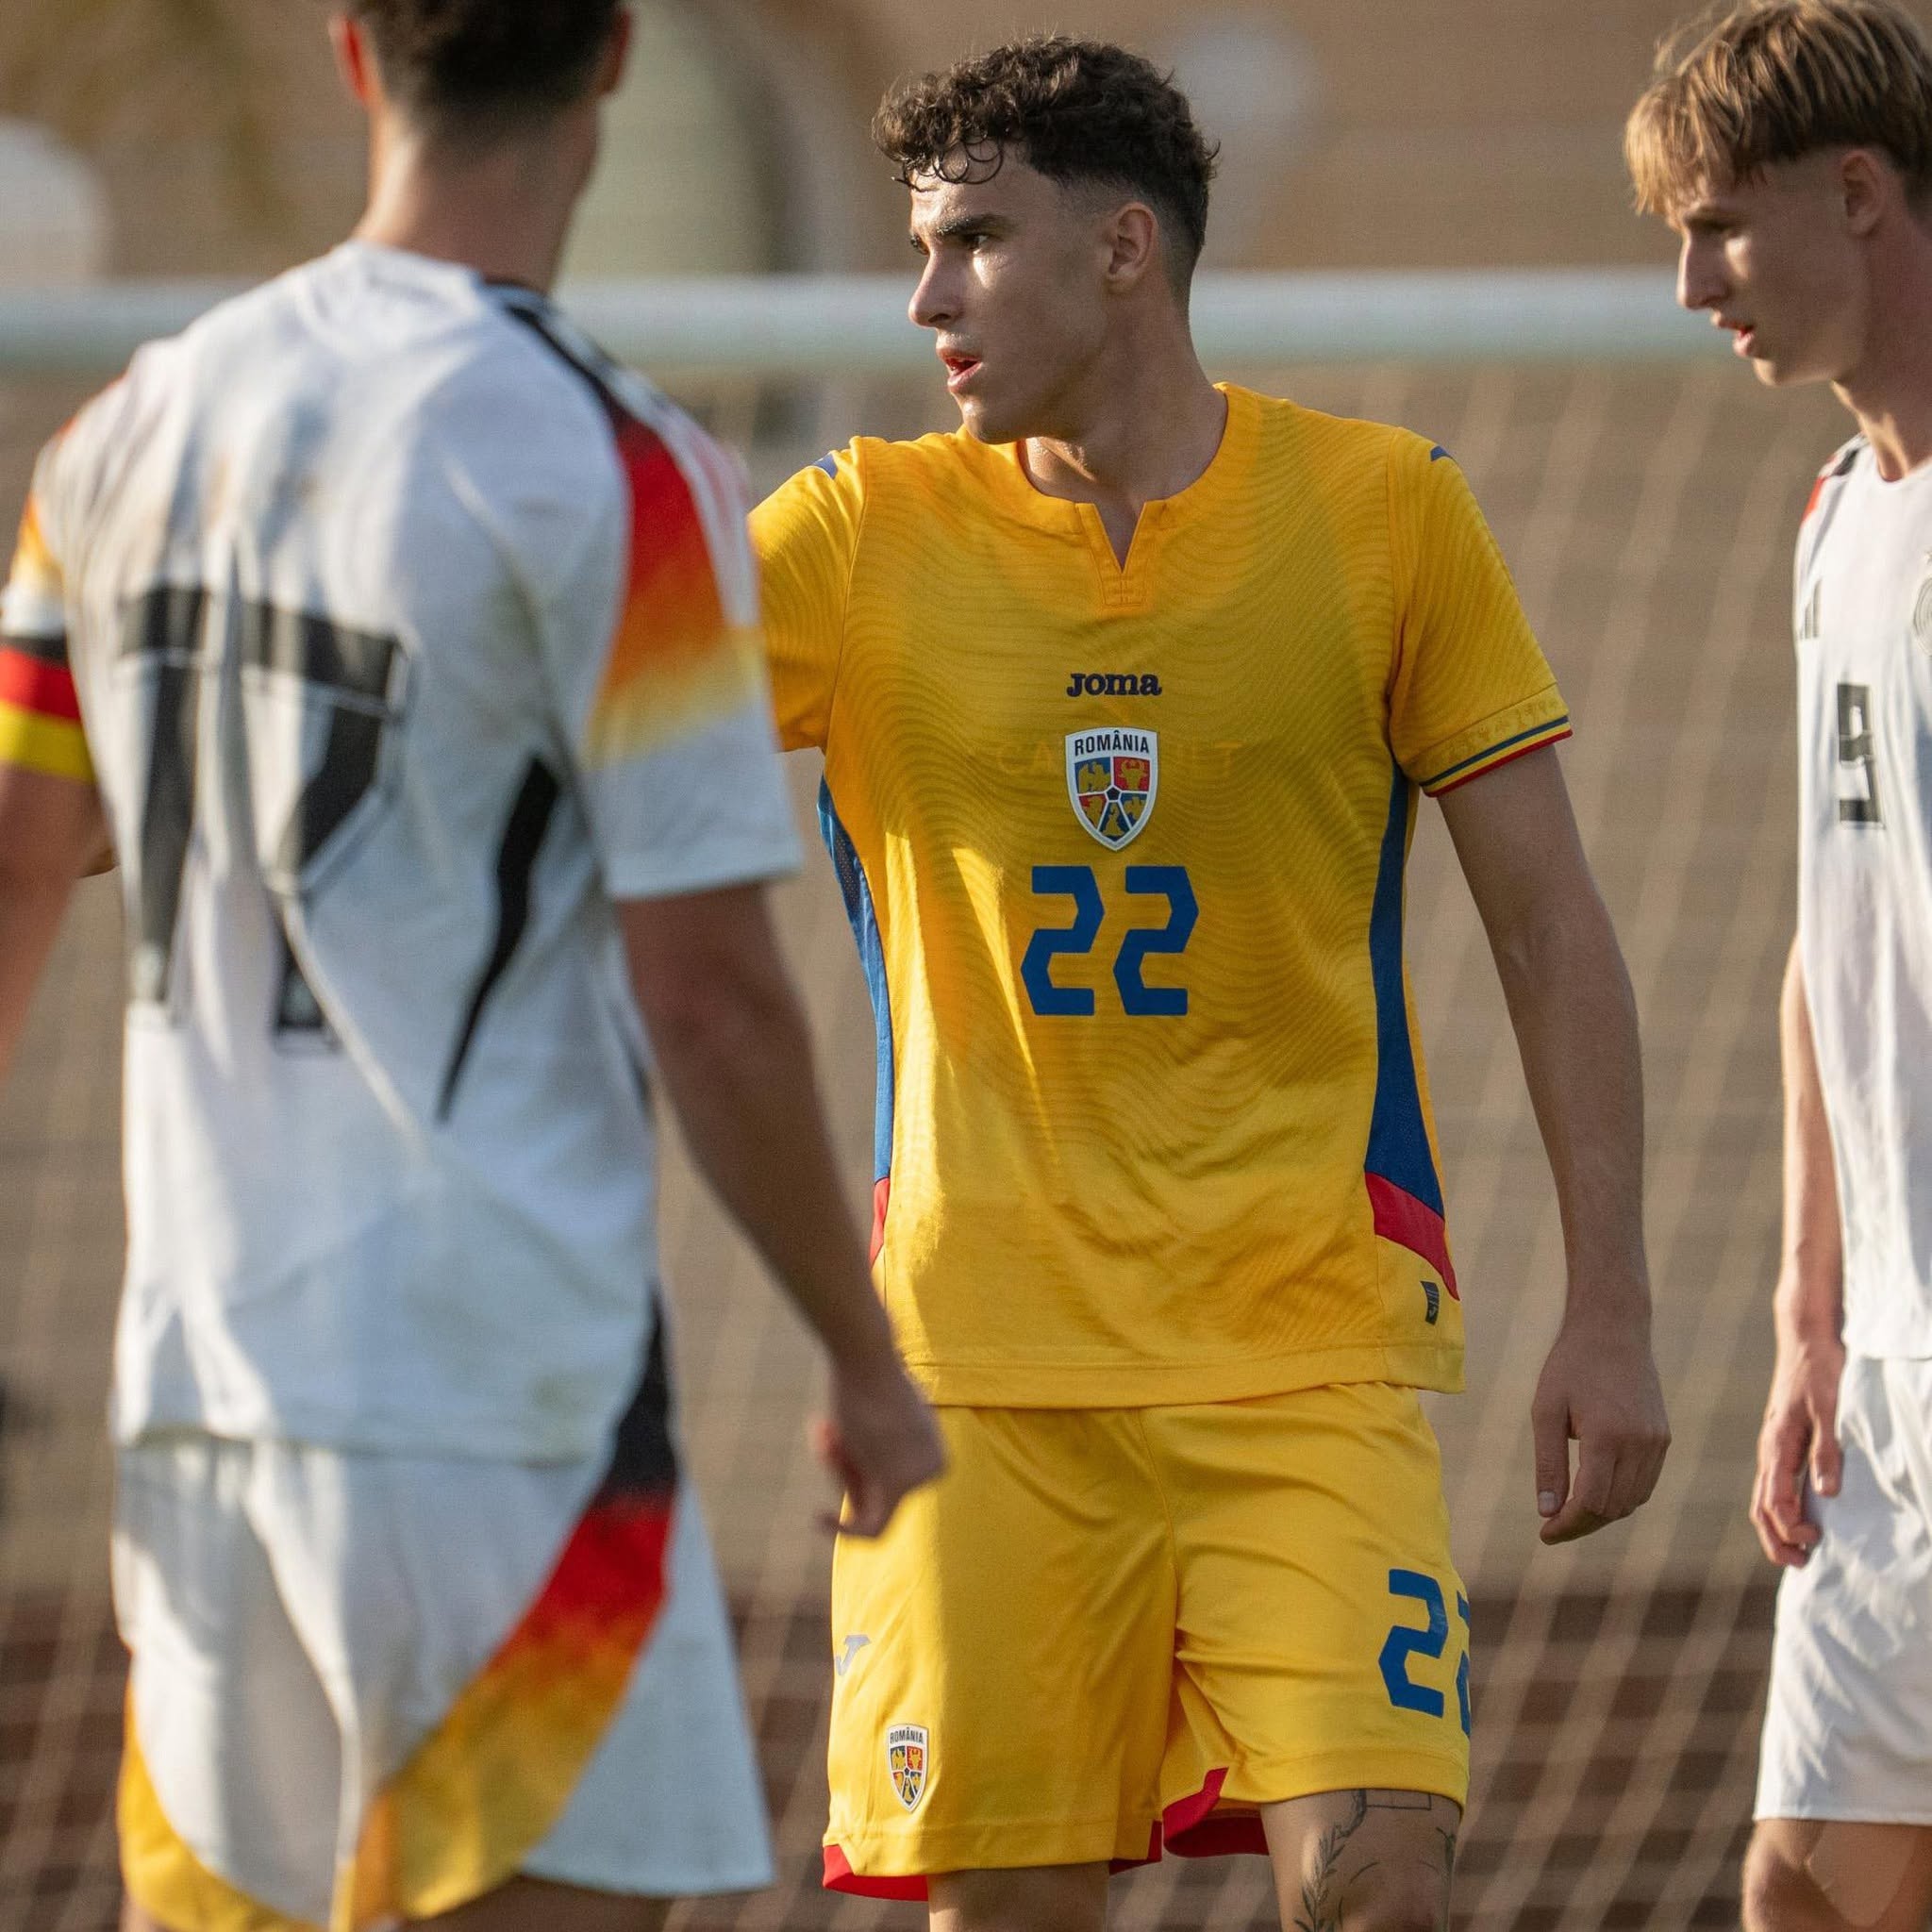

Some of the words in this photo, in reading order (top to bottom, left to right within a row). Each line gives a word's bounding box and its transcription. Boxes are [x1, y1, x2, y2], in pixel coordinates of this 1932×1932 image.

[118, 583, 400, 1032] 17
[1074, 729, 1150, 757] ROMÂNIA
[1837, 683, 1881, 824] 9
[1020, 865, 1200, 1017] 22
[890, 1726, 924, 1744] ROMÂNIA
